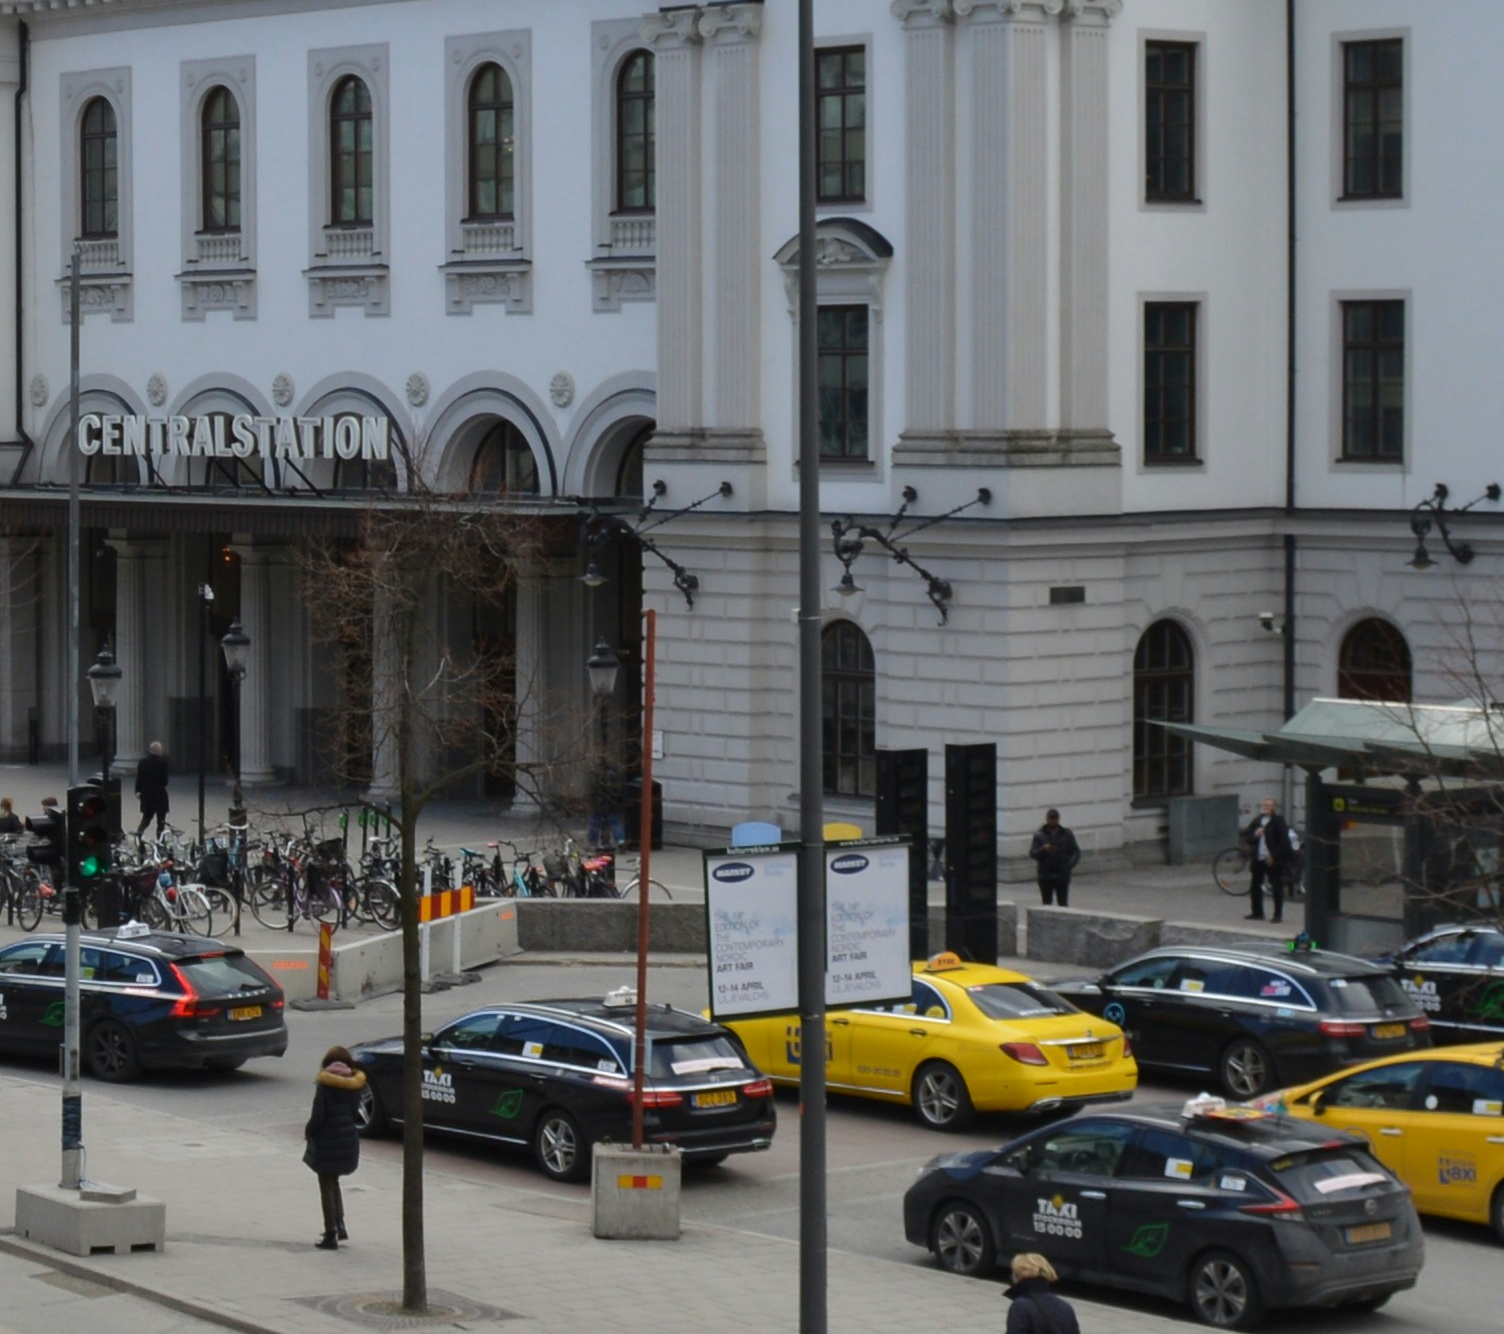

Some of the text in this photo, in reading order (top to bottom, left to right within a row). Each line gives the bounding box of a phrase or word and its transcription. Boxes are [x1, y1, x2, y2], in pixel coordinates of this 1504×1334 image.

[77, 414, 388, 460] CENTRALSTATION
[831, 929, 896, 944] CONTEMPORARY
[715, 938, 784, 953] CONTEMPORARY
[831, 942, 861, 953] NORDIC
[716, 951, 747, 962] NORDIC
[831, 951, 867, 963] ART FAIR
[716, 961, 754, 973] ART FAIR
[854, 971, 877, 980] APRIL
[741, 981, 765, 991] APRIL
[1400, 978, 1437, 995] TAXI
[423, 1069, 452, 1087] TAXI
[1037, 1198, 1078, 1219] TAXI
[1033, 1221, 1046, 1233] 15
